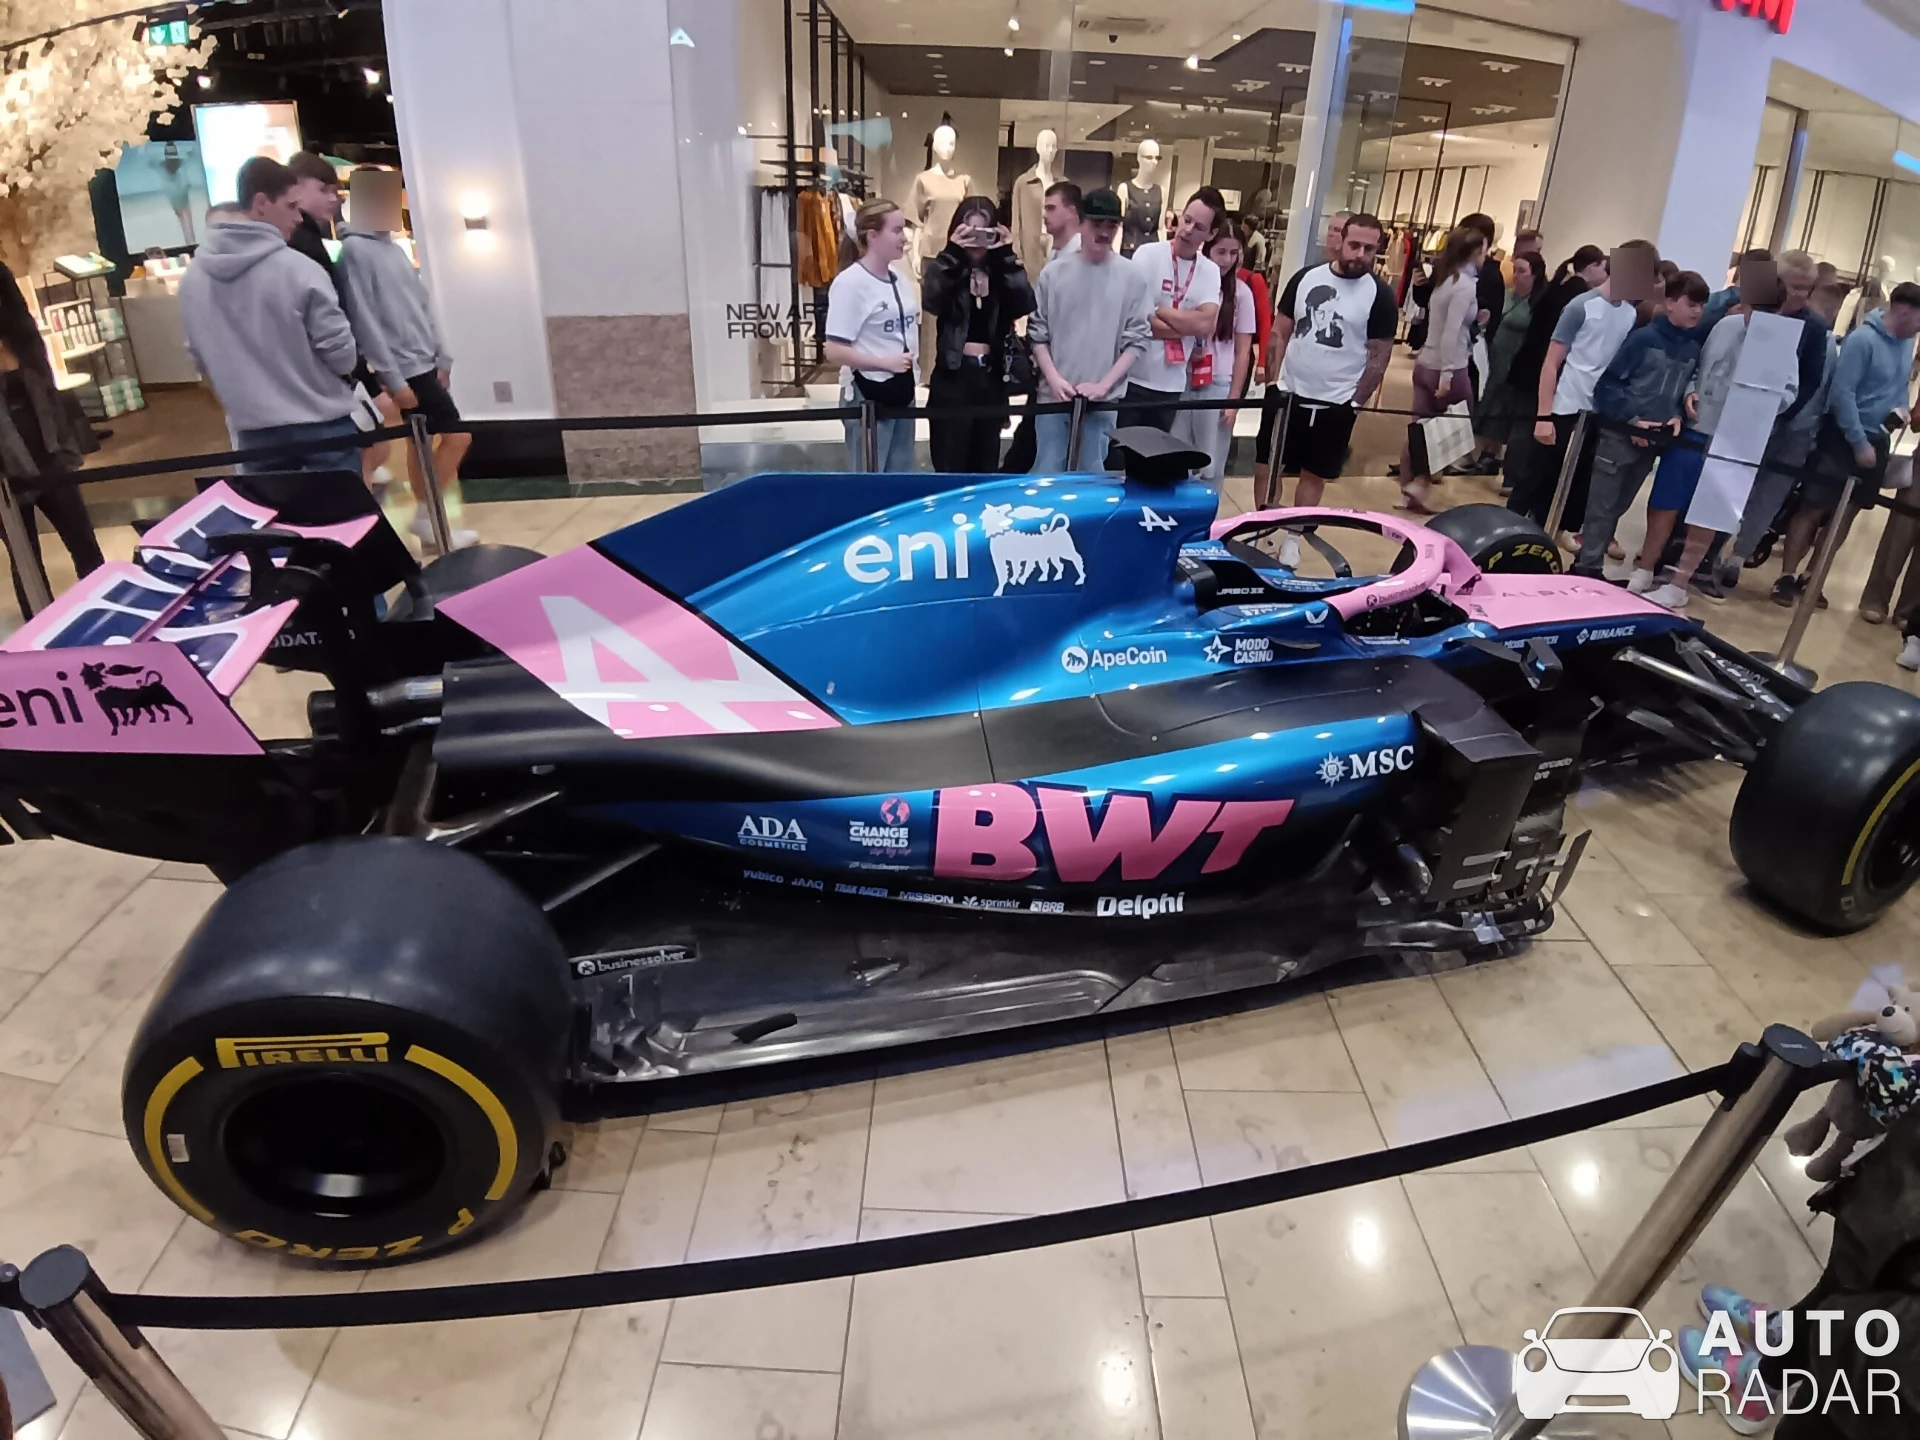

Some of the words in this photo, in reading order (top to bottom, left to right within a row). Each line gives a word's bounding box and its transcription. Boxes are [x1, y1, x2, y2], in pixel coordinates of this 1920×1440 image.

[726, 303, 780, 320] NEW
[727, 321, 794, 339] FROM
[843, 513, 969, 584] eni
[1511, 543, 1560, 574] ZERO
[1589, 625, 1636, 640] BINANCE
[1235, 638, 1269, 651] MODO
[1091, 646, 1167, 670] ApeCoin
[1234, 650, 1273, 664] CASINO
[1349, 745, 1414, 780] MSC
[738, 815, 806, 840] ADA
[849, 826, 908, 839] CHANGE
[934, 783, 1294, 882] BWT
[861, 837, 908, 848] WORLD
[900, 891, 954, 904] MISSION
[979, 898, 1020, 911] sprinklr
[1096, 891, 1186, 920] Delphi
[597, 949, 686, 972] businessolver
[215, 1032, 389, 1068] PIRELLI
[233, 1229, 423, 1260] ZERO
